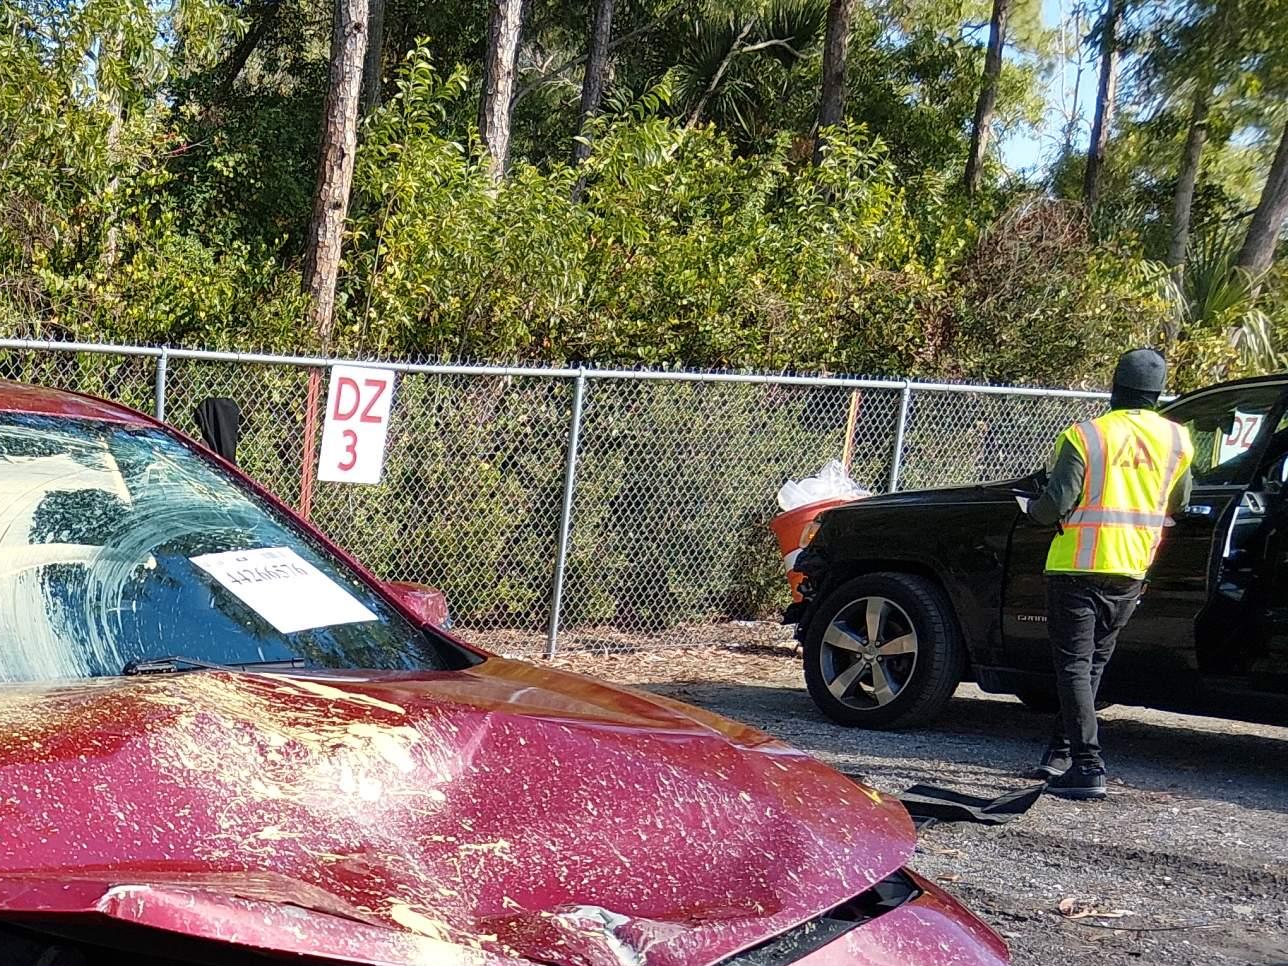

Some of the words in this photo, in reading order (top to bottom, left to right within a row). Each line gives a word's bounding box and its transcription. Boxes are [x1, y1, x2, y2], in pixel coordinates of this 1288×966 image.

[333, 377, 387, 423] DZ
[337, 429, 358, 471] 3
[227, 562, 309, 585] 44266576
